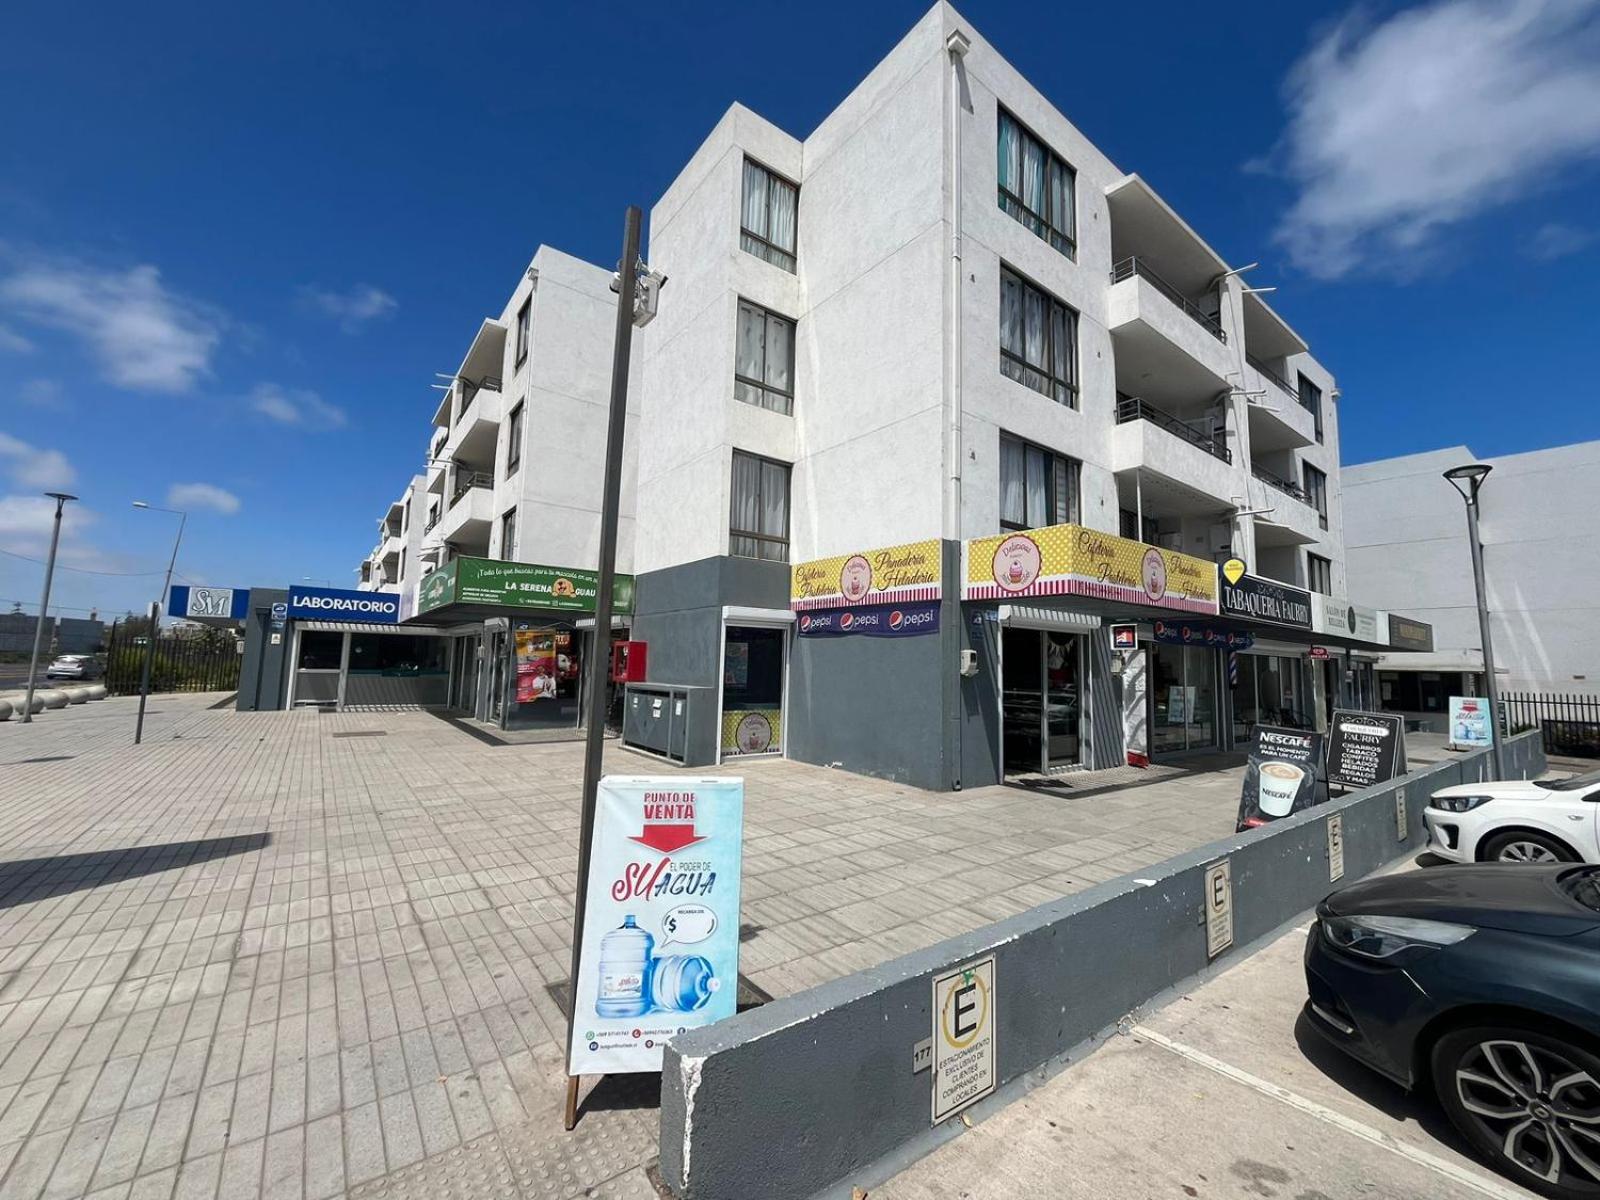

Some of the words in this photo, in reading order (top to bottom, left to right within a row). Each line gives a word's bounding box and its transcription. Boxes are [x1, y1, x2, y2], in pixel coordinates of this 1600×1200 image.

[505, 581, 517, 590] LA
[520, 583, 552, 593] SERENA
[575, 587, 596, 597] GUAU
[293, 595, 396, 614] LABORATORIO
[810, 616, 832, 628] pepsi
[854, 614, 879, 628] pepsi
[904, 609, 934, 625] pepsi
[1342, 742, 1381, 753] CIGARROS
[1346, 748, 1377, 758] TABACO
[1341, 758, 1378, 768] HELADOS
[1342, 753, 1379, 763] CONFITES
[1340, 768, 1376, 779] REGALOS
[1342, 763, 1376, 773] BEBIDAS
[644, 793, 680, 802] PUNTO
[682, 793, 696, 802] DE
[643, 805, 694, 819] VENTA
[670, 862, 678, 872] EL
[679, 862, 701, 872] PODER
[702, 862, 712, 871] DE
[654, 872, 717, 897] AGUA
[1214, 874, 1224, 907] E
[668, 917, 677, 933] $
[954, 982, 977, 1039] E
[939, 1037, 990, 1070] ESTACIONAMIENTO
[945, 1053, 977, 1077] EXCLUSIVO
[976, 1049, 985, 1061] DE
[951, 1062, 979, 1084] CLIENTES
[942, 1074, 979, 1100] COMPRANDO
[979, 1069, 987, 1080] EN
[952, 1083, 978, 1105] LOCALES
